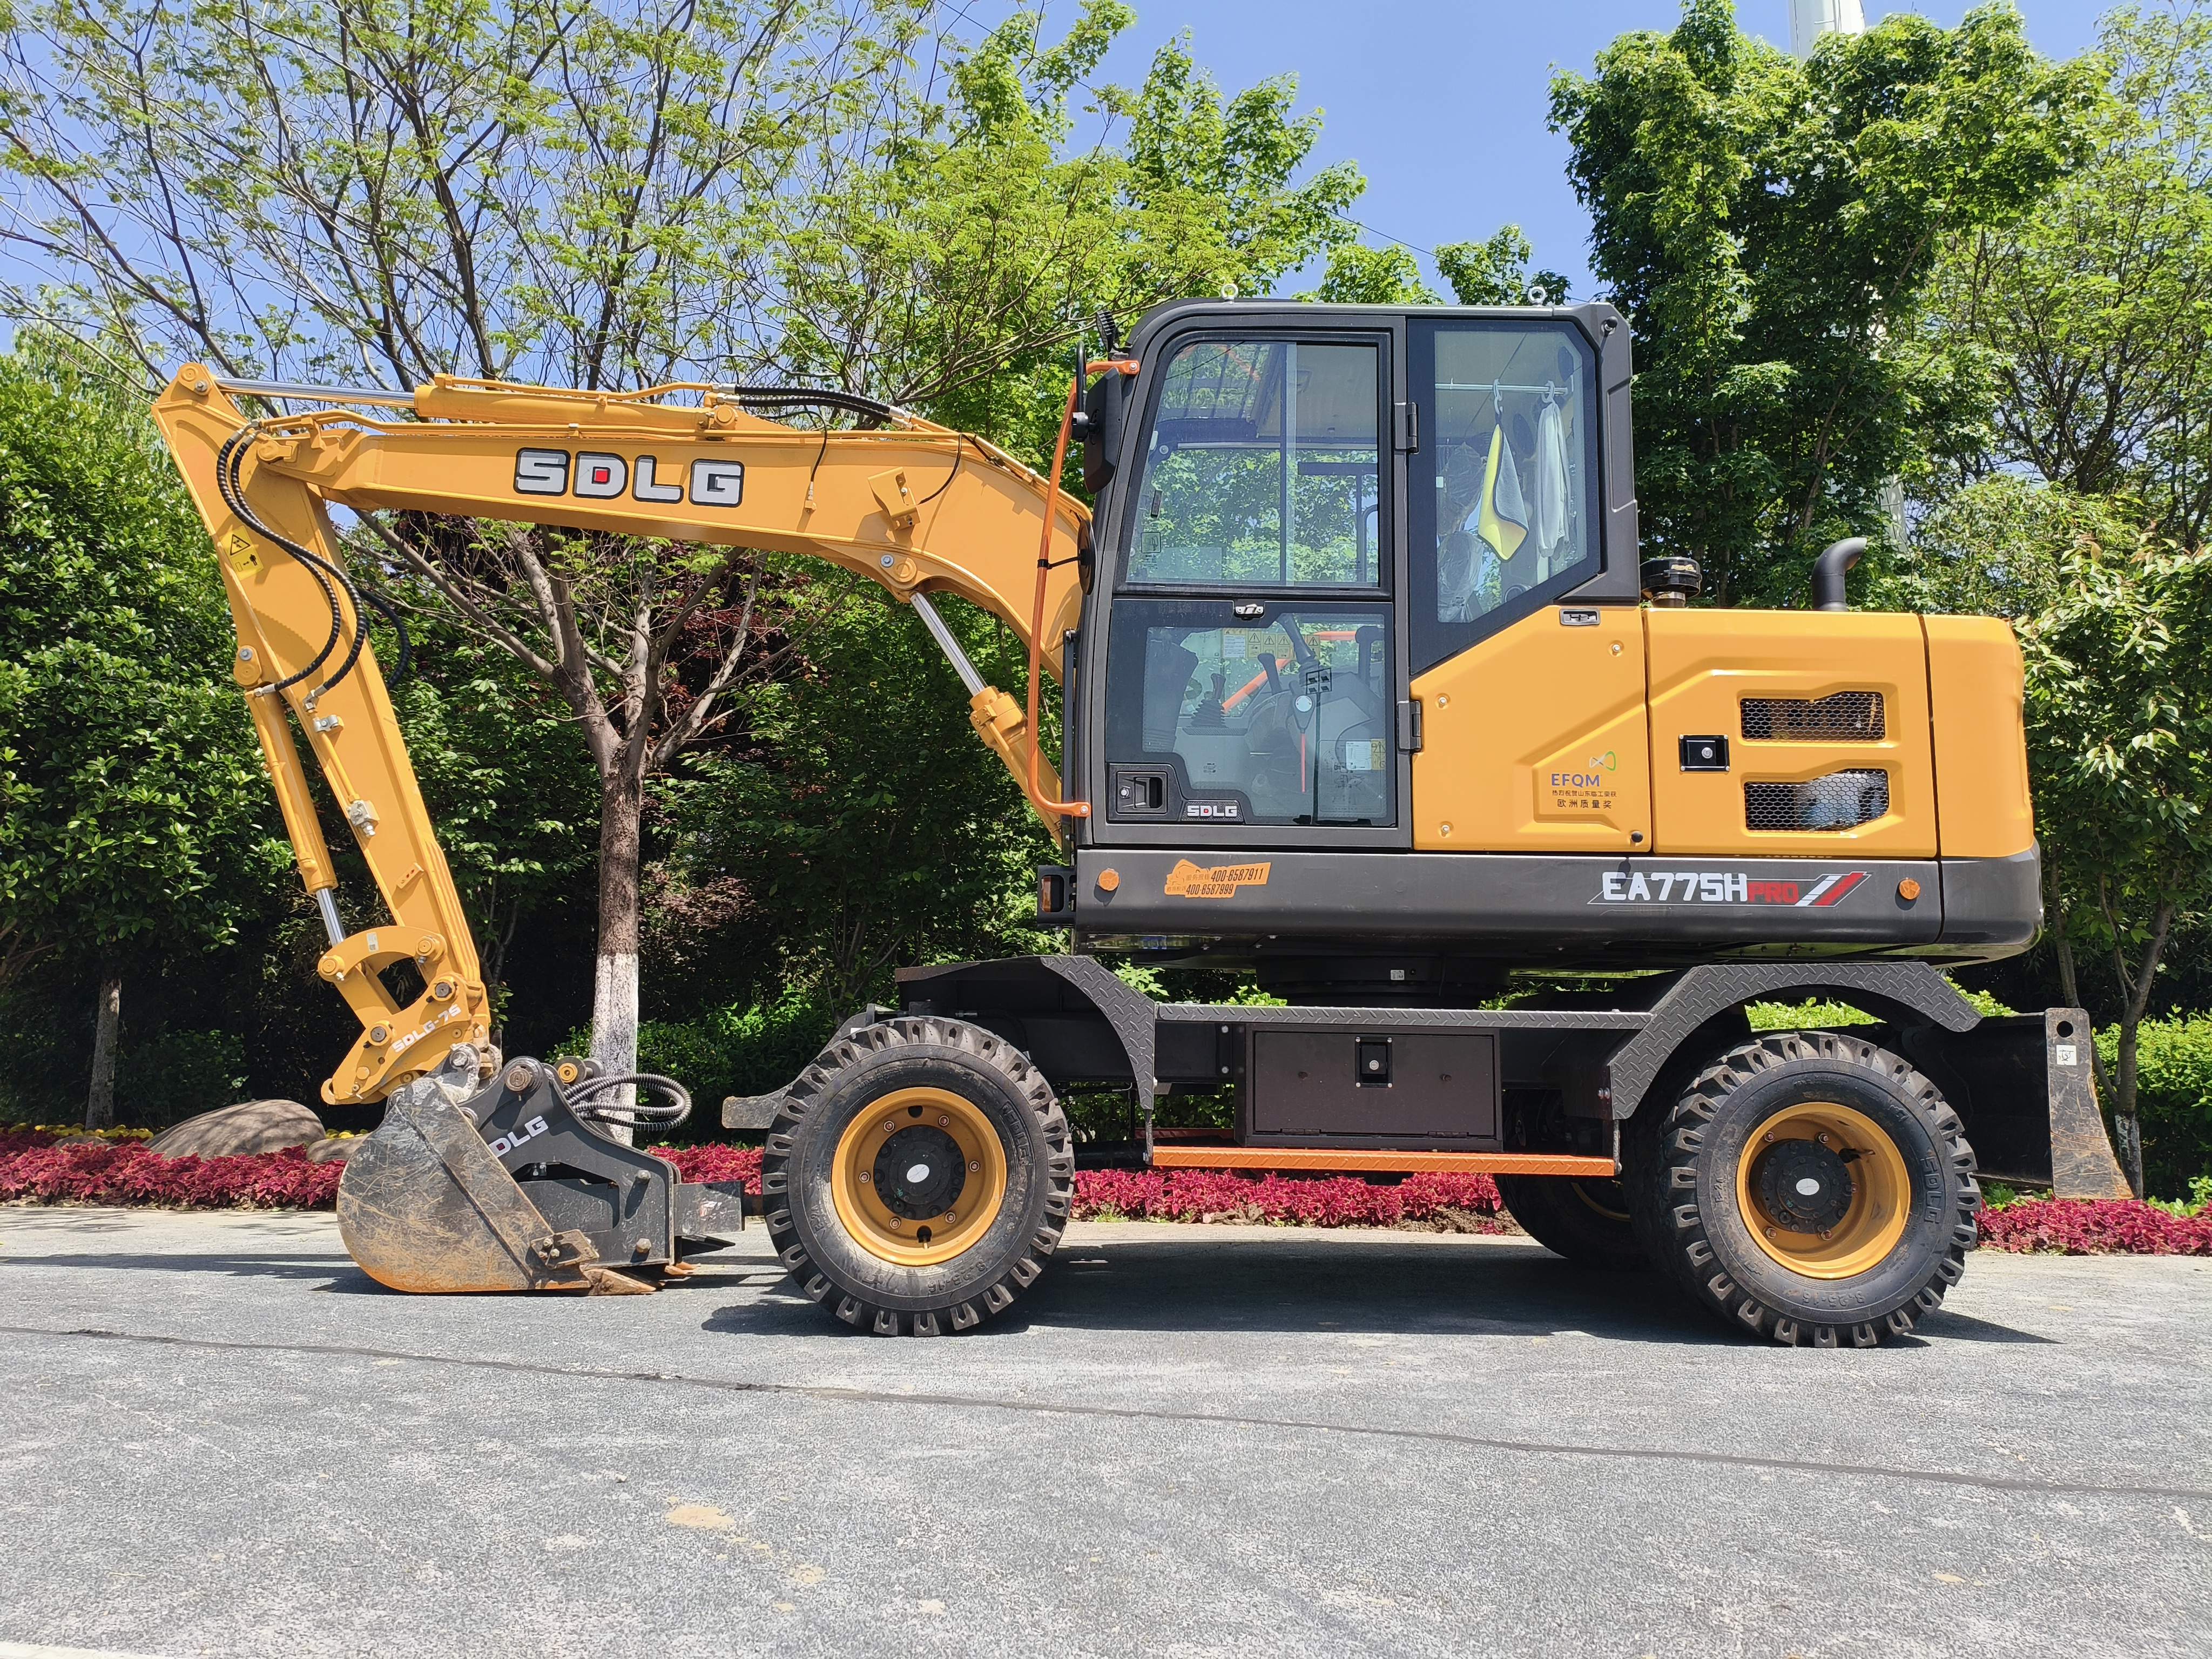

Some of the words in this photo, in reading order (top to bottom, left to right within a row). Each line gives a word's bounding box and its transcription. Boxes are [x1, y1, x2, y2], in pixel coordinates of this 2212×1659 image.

[514, 448, 745, 507] SDLG
[1552, 773, 1600, 787] EFQM
[1187, 805, 1237, 818] SDLG
[1557, 799, 1612, 809] 欧洲质量奖
[1211, 868, 1264, 882] 400-6587911
[1186, 884, 1234, 895] 400-6587999
[1602, 872, 1748, 902] EA775H
[1748, 881, 1799, 904] PRO
[392, 1004, 462, 1053] SDLG-7S
[488, 1116, 549, 1158] DLG
[1920, 1156, 1941, 1224] SDLG
